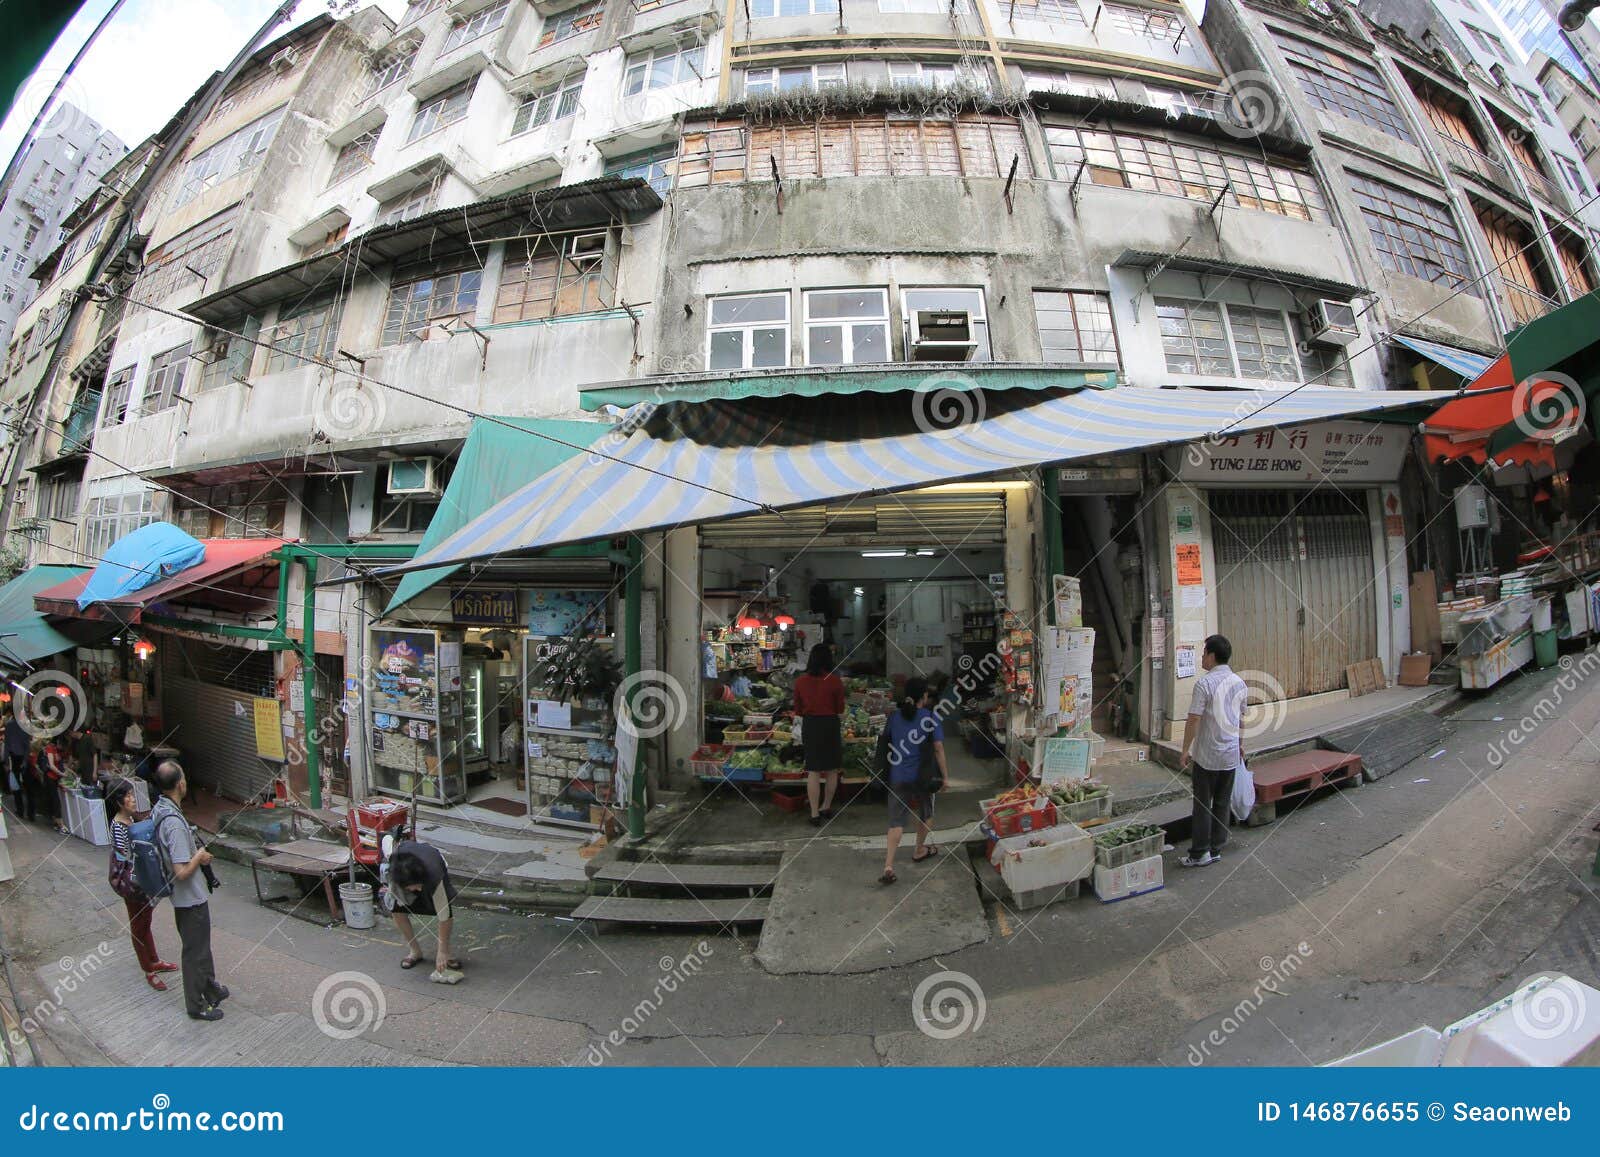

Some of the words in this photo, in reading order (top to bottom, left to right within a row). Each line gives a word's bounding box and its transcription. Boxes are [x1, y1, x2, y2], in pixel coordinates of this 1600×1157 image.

[1210, 458, 1244, 472] YUNG
[1247, 458, 1269, 471] LEE
[1271, 459, 1302, 472] HONG
